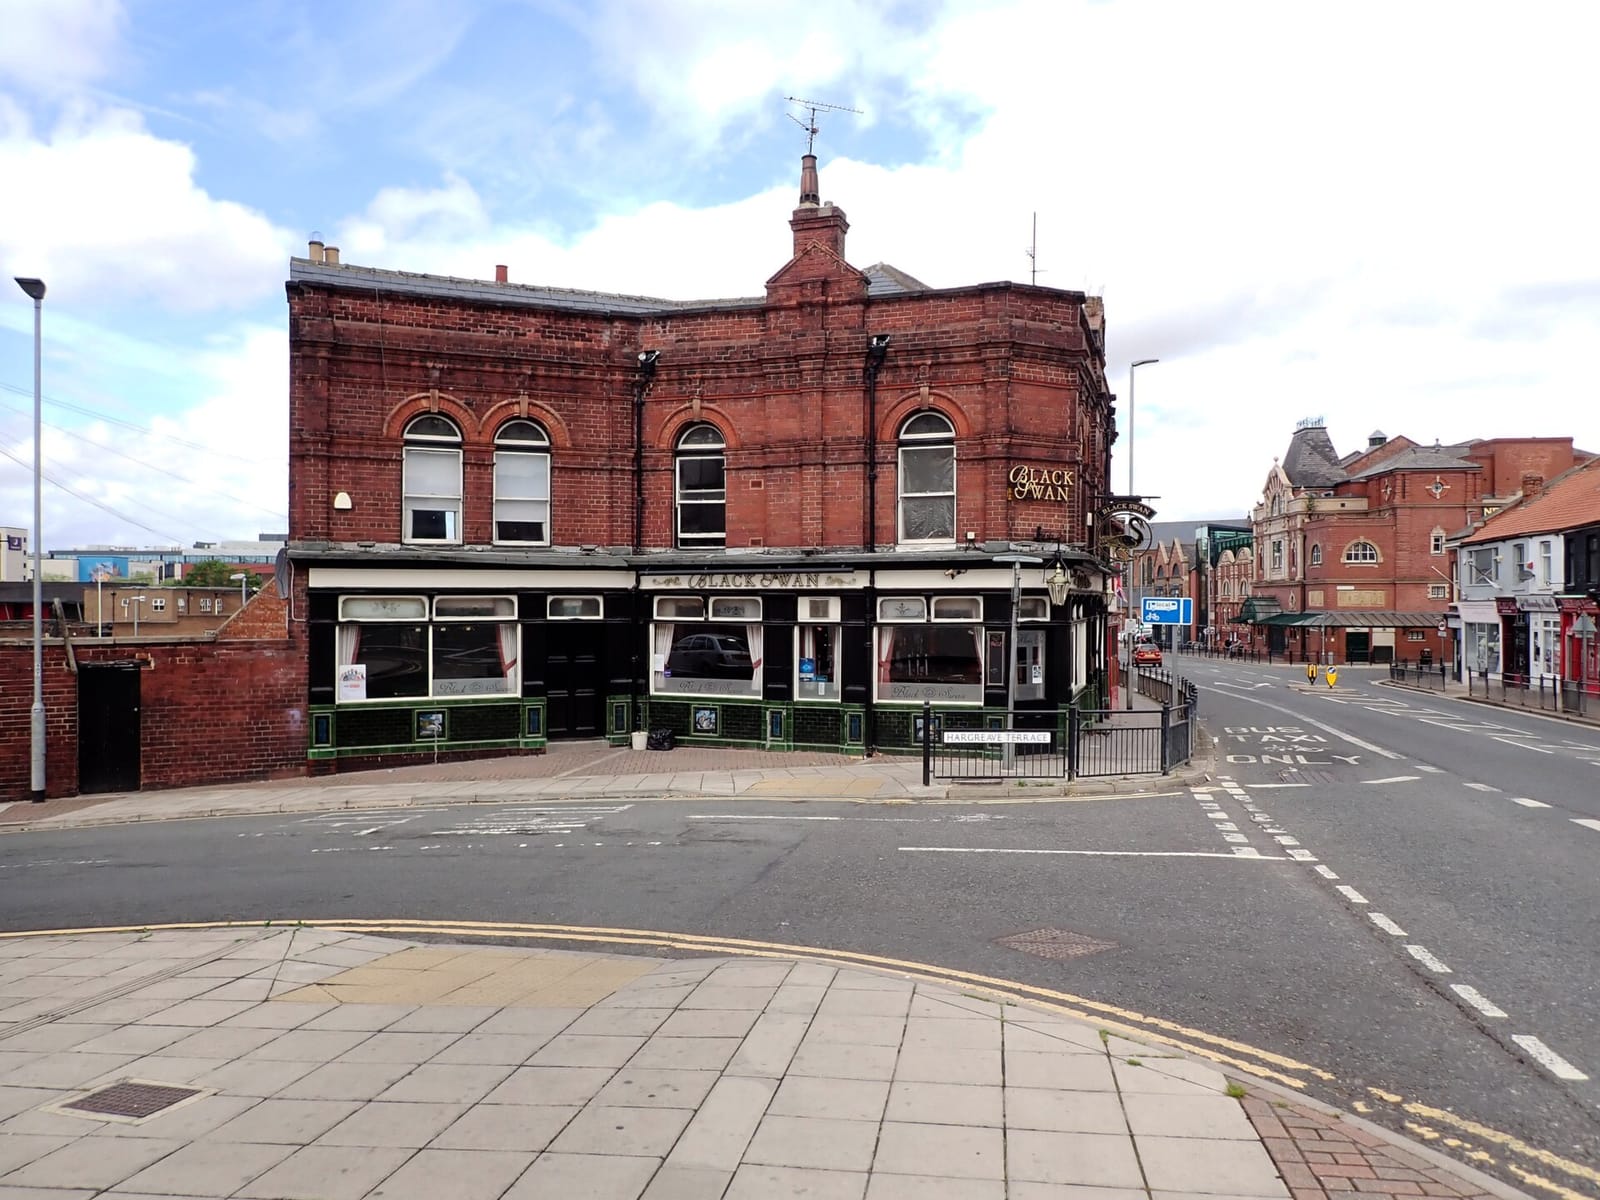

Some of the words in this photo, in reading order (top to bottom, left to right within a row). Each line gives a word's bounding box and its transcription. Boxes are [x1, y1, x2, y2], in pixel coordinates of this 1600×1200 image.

[1009, 465, 1074, 486] BLACK
[1014, 480, 1069, 502] SWAN
[1101, 503, 1128, 516] BLACK
[1128, 503, 1151, 515] SWAN
[688, 573, 756, 588] BLACK
[760, 573, 820, 588] SWAN
[1223, 726, 1304, 734] BUS
[946, 733, 1003, 742] HARGREAVE
[1006, 733, 1048, 742] TERRACE
[1227, 734, 1328, 743] TAXI
[1225, 754, 1361, 765] ONLY
